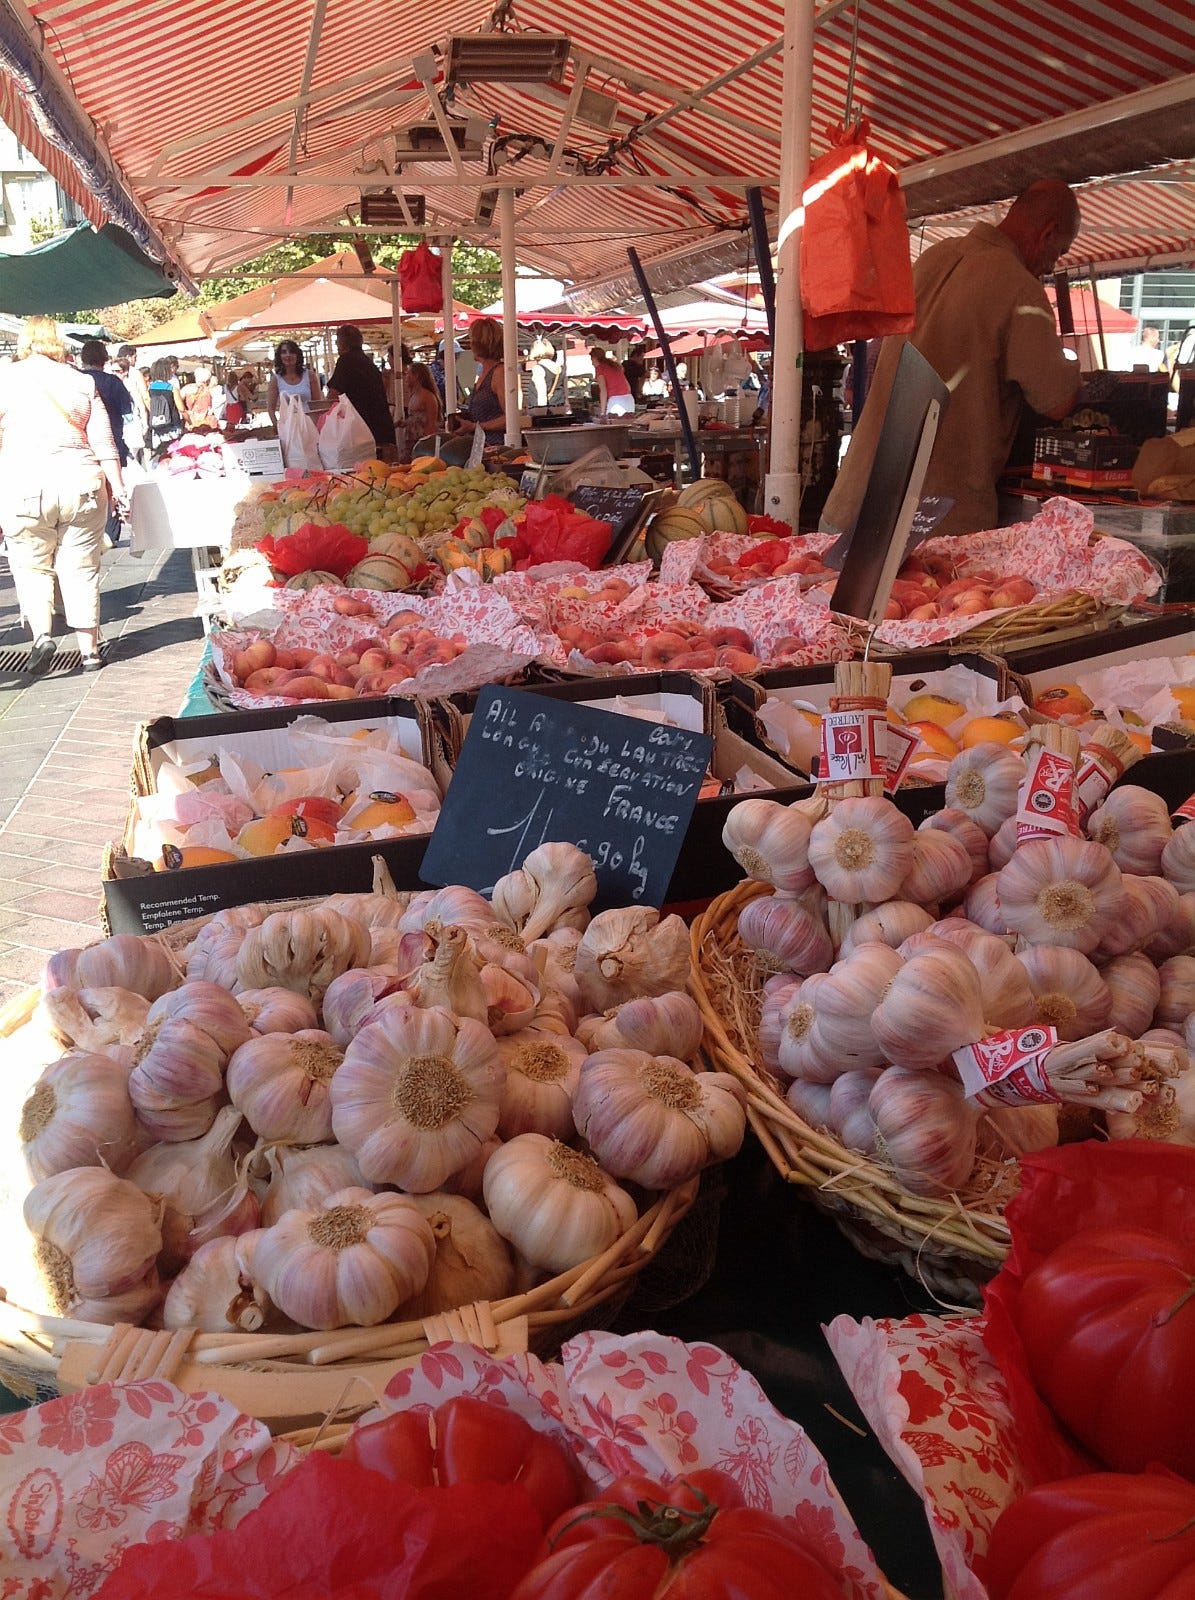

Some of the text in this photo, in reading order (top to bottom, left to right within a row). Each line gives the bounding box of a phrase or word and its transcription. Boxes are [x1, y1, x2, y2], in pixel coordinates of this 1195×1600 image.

[829, 715, 865, 727] LAUTREC
[603, 784, 679, 834] FRANCE
[140, 893, 221, 910] Recommended Temp.
[182, 906, 204, 915] Temp.
[143, 921, 166, 930] Temp.
